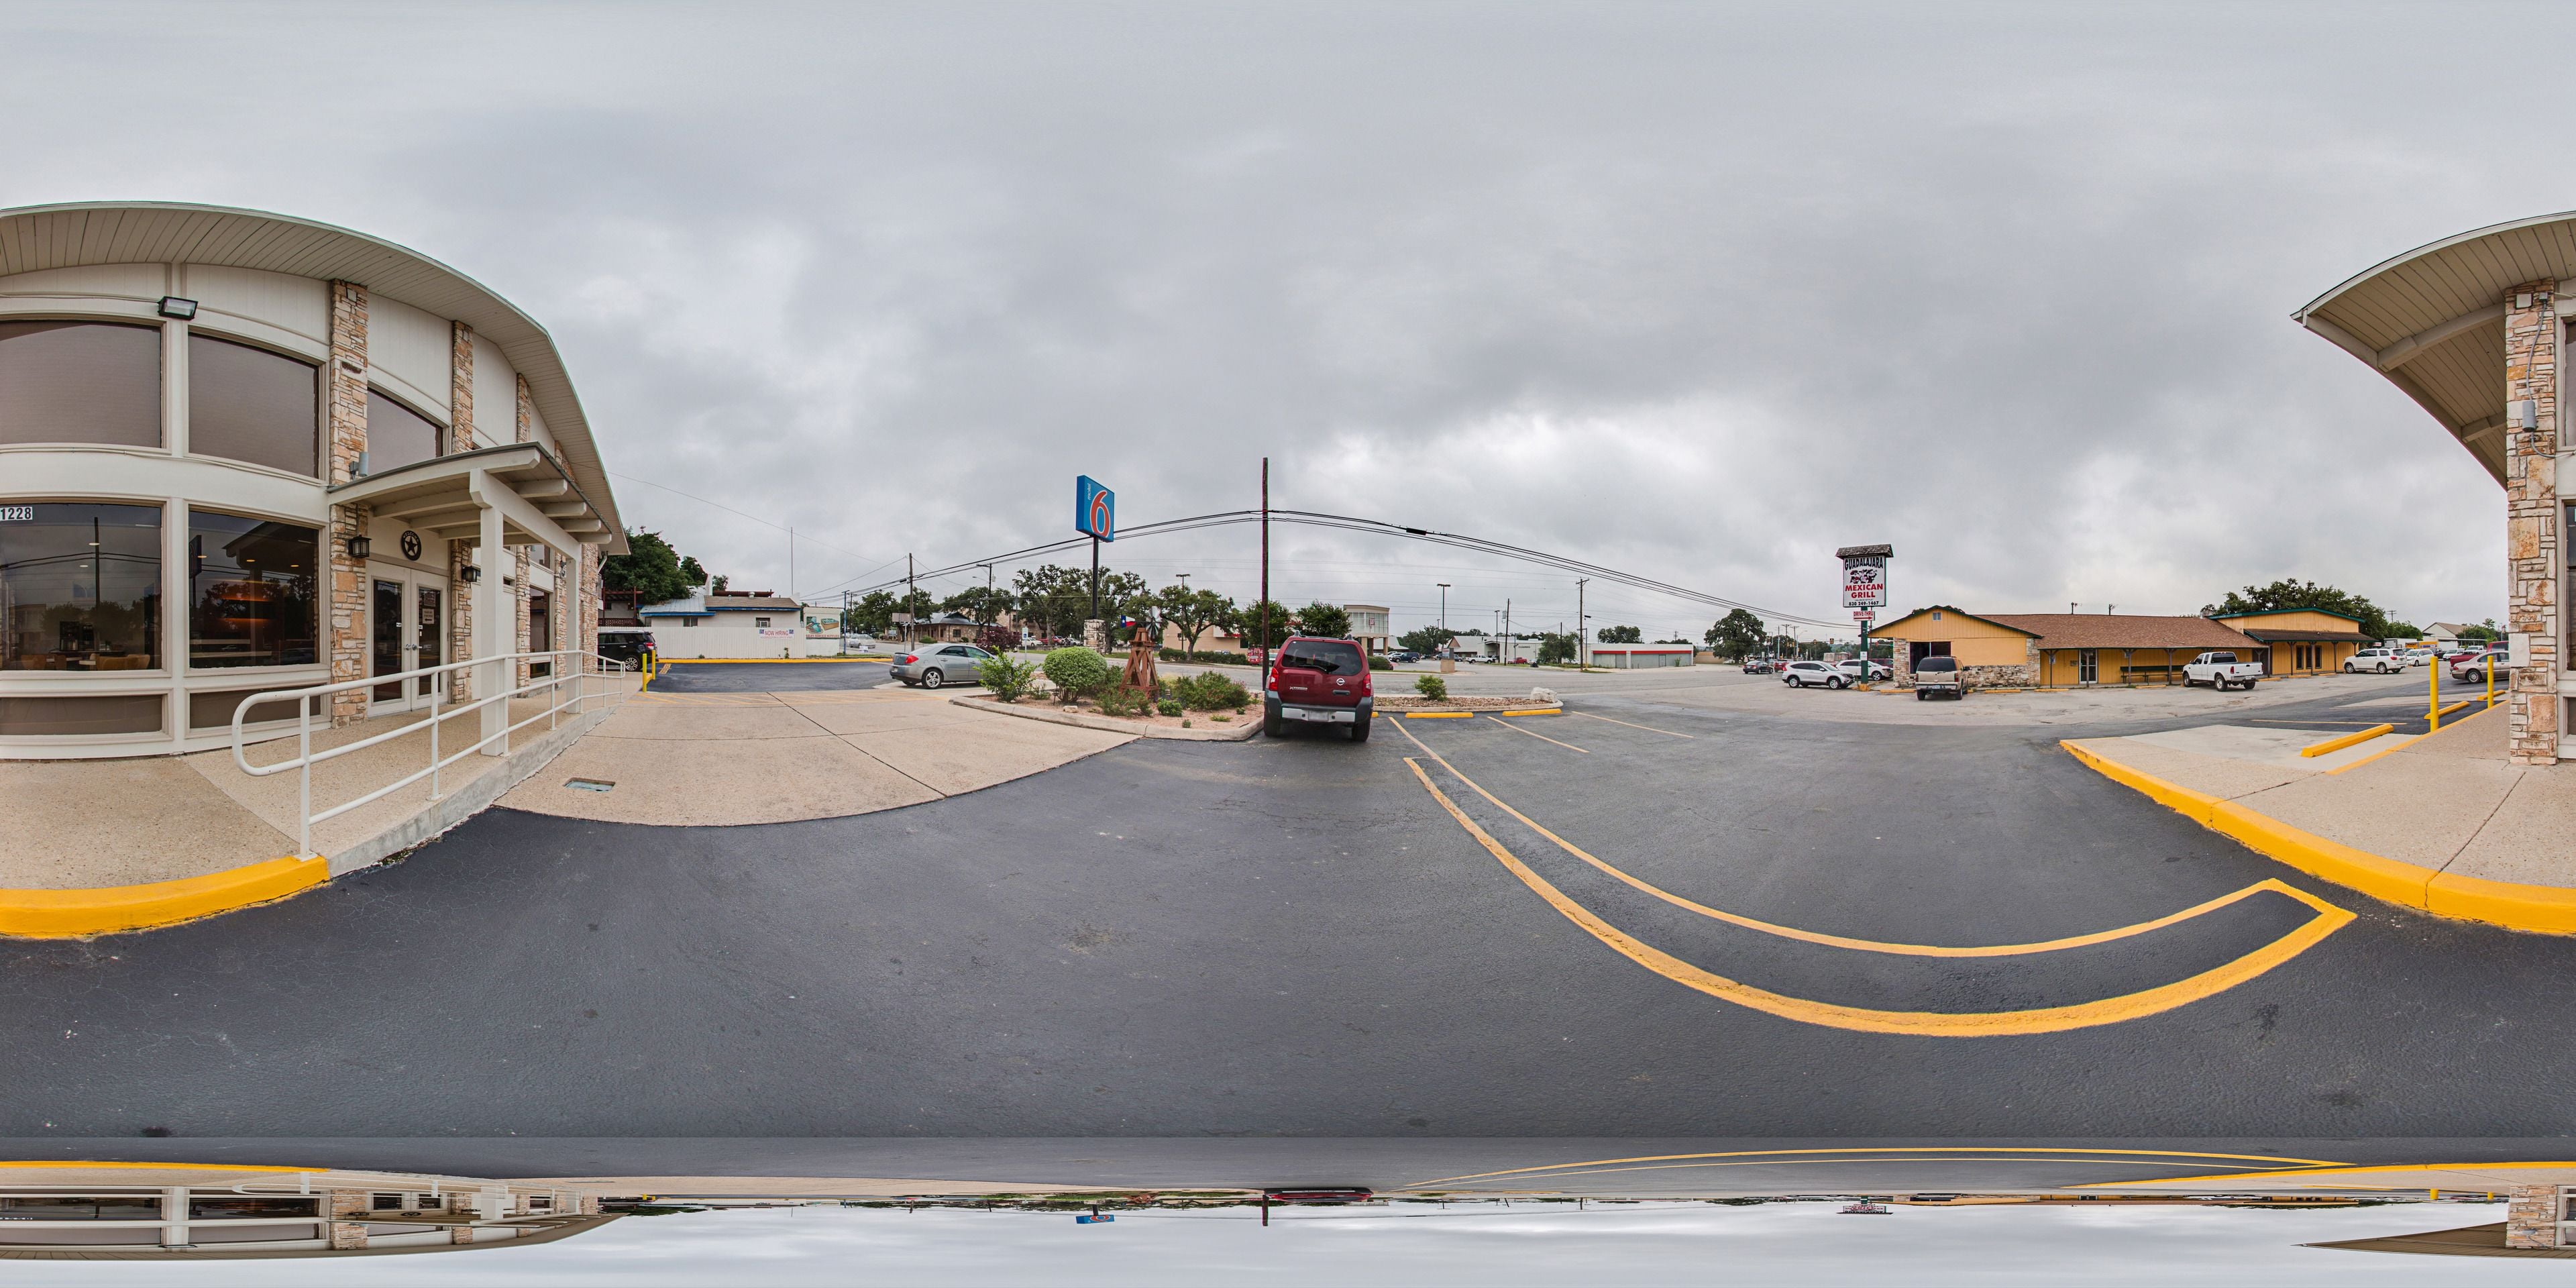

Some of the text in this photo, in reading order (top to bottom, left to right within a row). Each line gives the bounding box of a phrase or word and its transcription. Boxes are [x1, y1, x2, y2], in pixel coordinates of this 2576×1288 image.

[1, 507, 32, 520] 1228
[1089, 490, 1111, 538] 6
[1844, 557, 1884, 571] GUADALAJARA
[1845, 584, 1883, 592] MEXICAN
